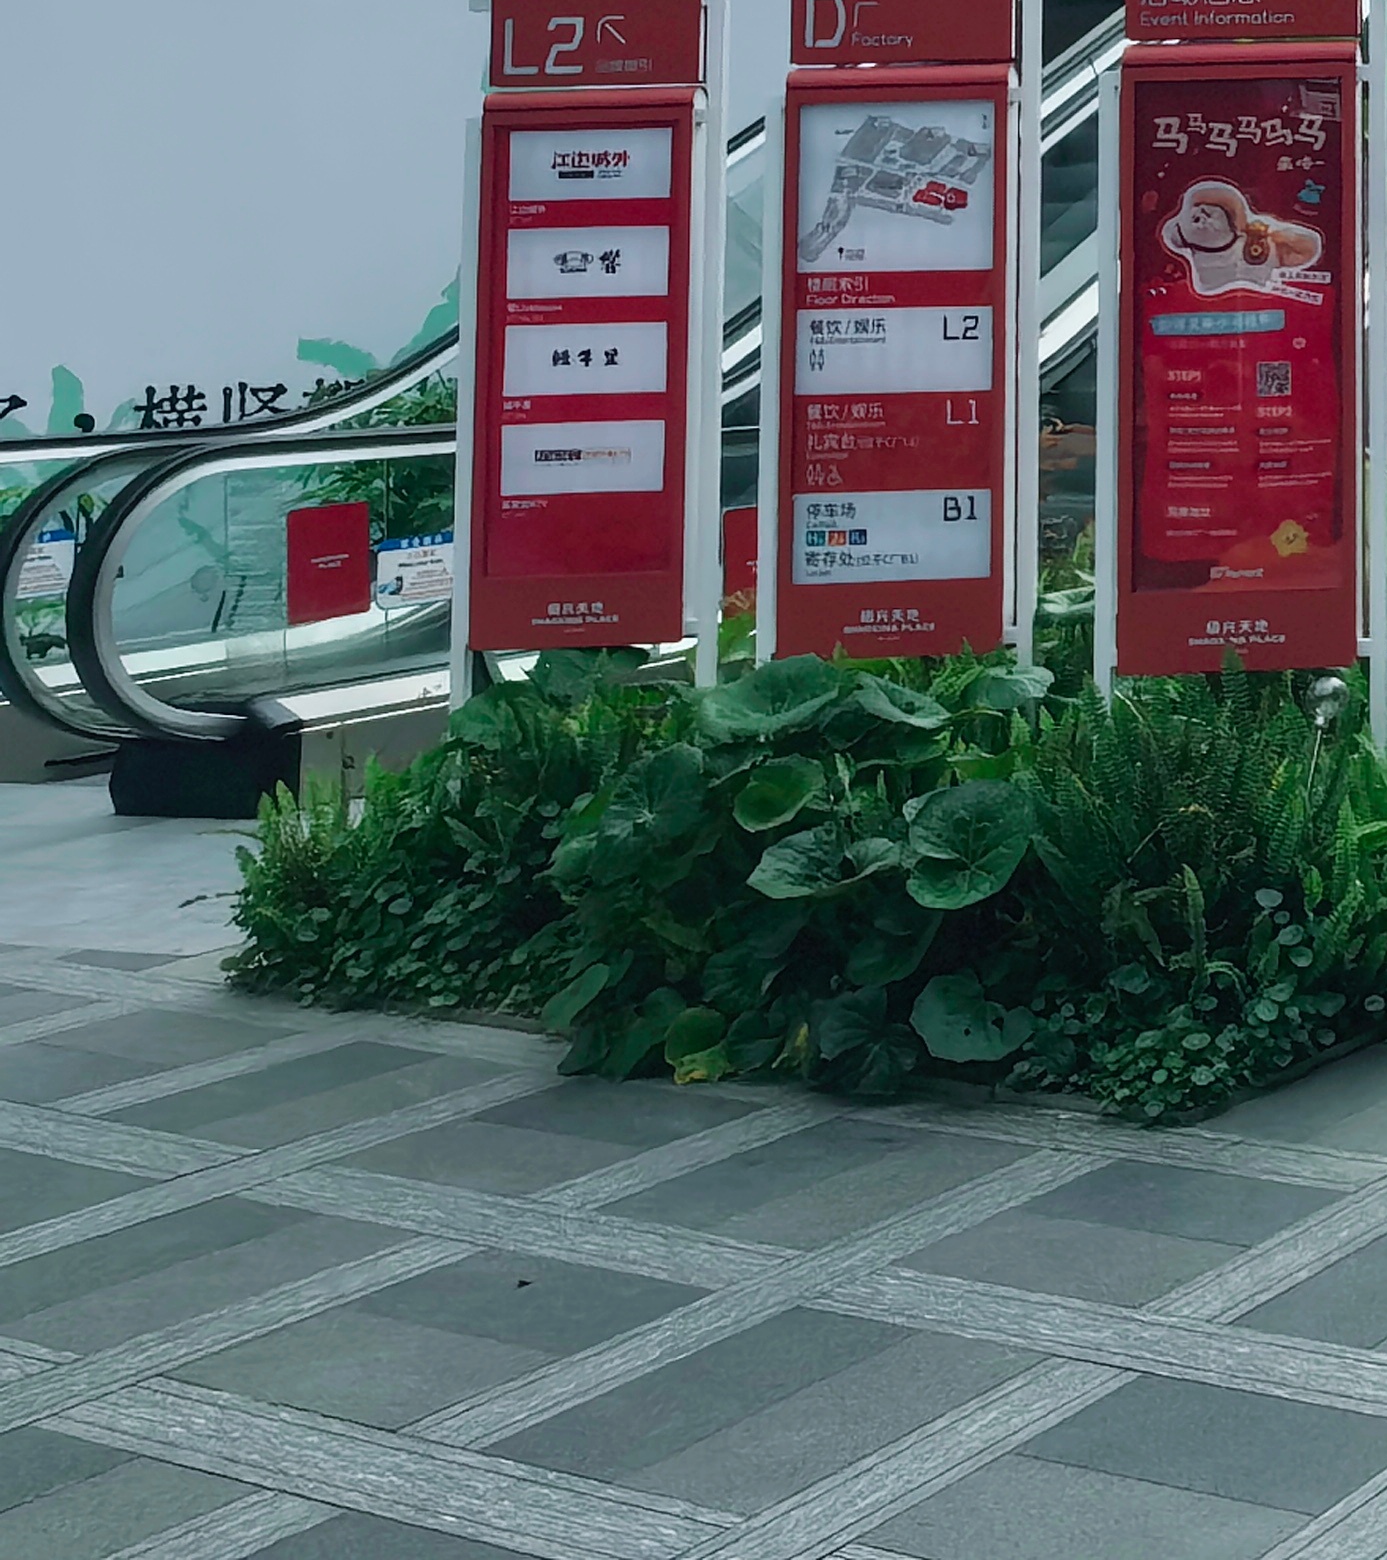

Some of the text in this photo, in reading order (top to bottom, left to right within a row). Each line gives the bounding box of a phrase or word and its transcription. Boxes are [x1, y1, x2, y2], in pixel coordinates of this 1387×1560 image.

[1140, 9, 1295, 26] Event Information
[503, 16, 585, 76] L2
[851, 31, 914, 48] Factory
[806, 294, 838, 305] Floor
[943, 314, 980, 341] L2
[946, 398, 980, 425] L1
[806, 495, 978, 522] 停车场 B1
